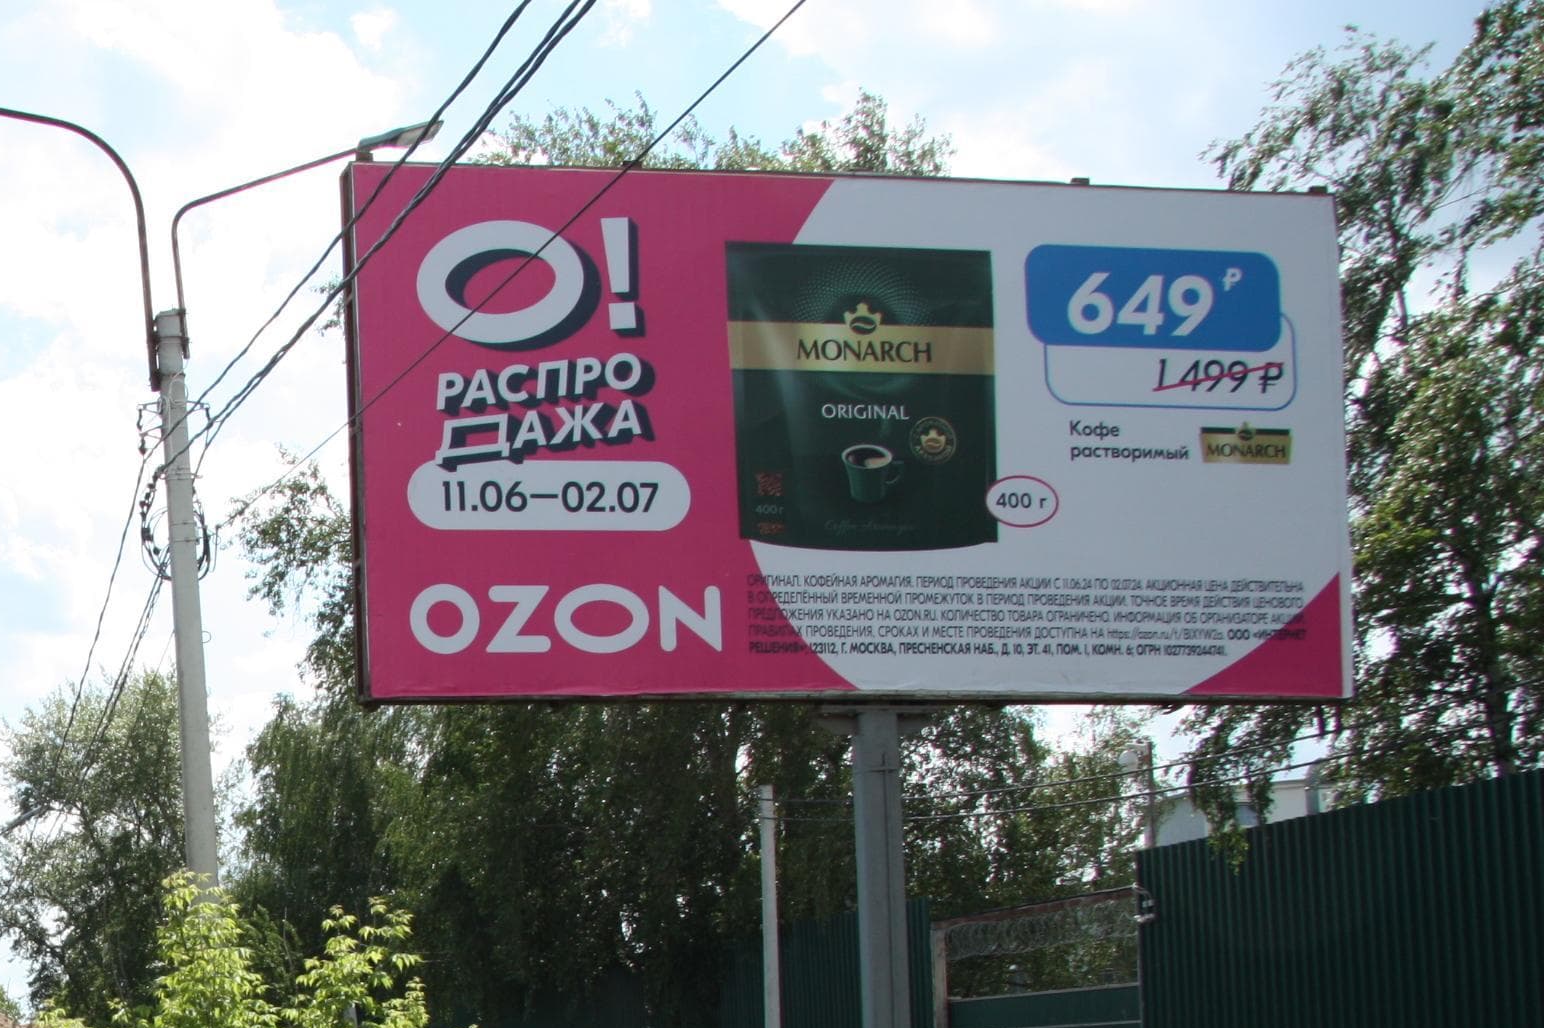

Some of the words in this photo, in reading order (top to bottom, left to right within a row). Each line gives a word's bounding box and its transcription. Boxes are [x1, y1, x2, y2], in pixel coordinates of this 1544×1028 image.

[1067, 271, 1214, 337] 649
[796, 338, 933, 364] MONARCH
[436, 353, 646, 412] РАСПРО
[821, 403, 910, 421] ORIGINAL
[435, 399, 646, 466] ДАЖА
[1069, 420, 1120, 440] Кофе
[1070, 444, 1189, 463] растворимый
[1206, 442, 1286, 459] MONARCH
[755, 504, 777, 514] 400
[996, 492, 1032, 509] 400
[1039, 496, 1047, 508] г
[804, 574, 857, 588] КОФЕЙНАЯ
[917, 577, 954, 590] ПЕРИОД
[957, 577, 1017, 590] ПРОВЕДЕНИЯ
[1019, 578, 1052, 590] АКЦИИ
[1094, 578, 1108, 590] ПО
[841, 591, 902, 604] ВРЕМЕННОЙ
[905, 594, 974, 605] ПРОМЕЖУТОК
[977, 594, 984, 605] В
[986, 594, 1025, 606] ПЕРИОД
[1027, 595, 1089, 607] ПРОВЕДЕНИЯ
[409, 583, 723, 655] OZON
[825, 610, 873, 621] УКАЗАНО
[877, 610, 891, 621] НА
[940, 611, 1005, 622] КОЛИЧЕСТВО
[1007, 611, 1044, 622] ТОВАРА
[877, 626, 918, 638] СРОКАХ
[922, 627, 929, 638] И
[932, 627, 964, 638] МЕСТЕ
[966, 627, 1031, 639] ПРОВЕДЕНИЯ
[1034, 627, 1088, 640] ДОСТУПНА
[1091, 628, 1104, 639] НА
[899, 644, 971, 655] ПРЕСНЕНСКАЯ
